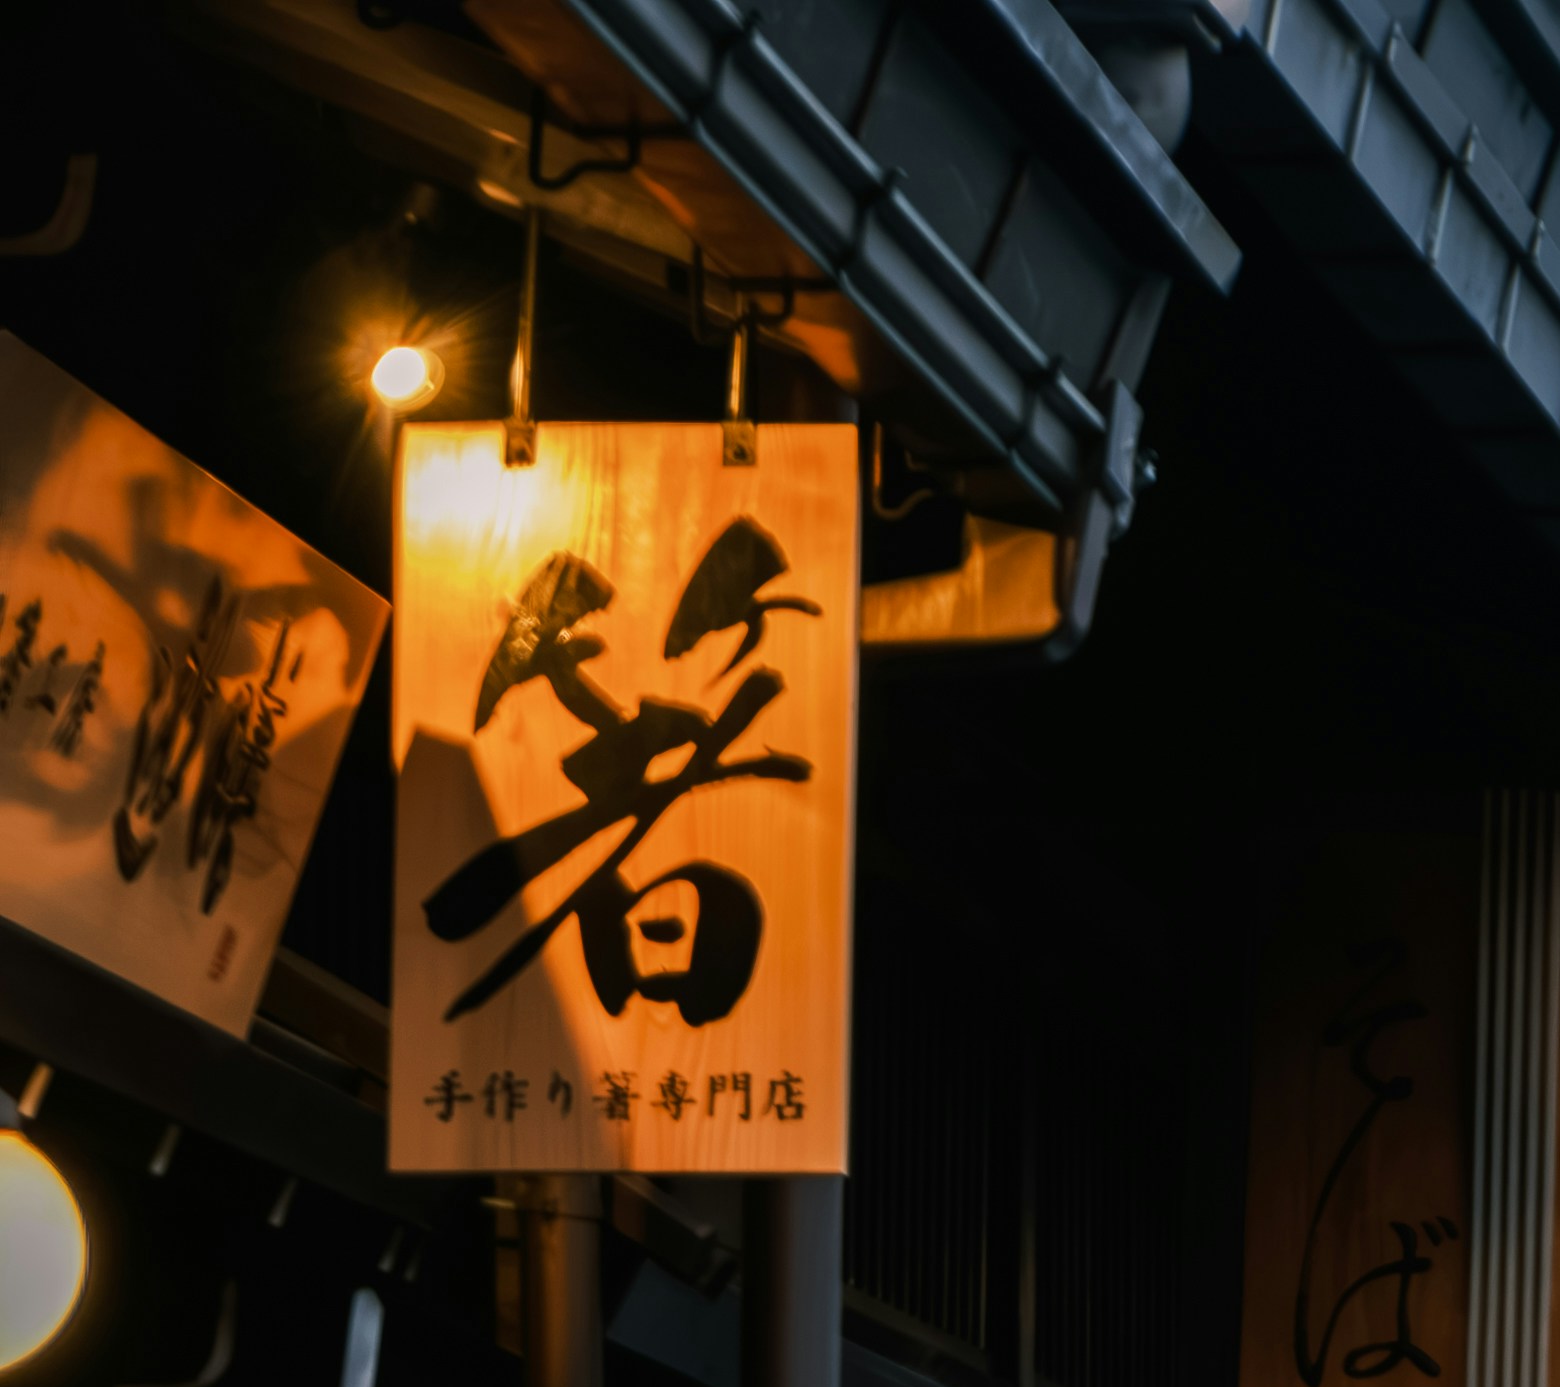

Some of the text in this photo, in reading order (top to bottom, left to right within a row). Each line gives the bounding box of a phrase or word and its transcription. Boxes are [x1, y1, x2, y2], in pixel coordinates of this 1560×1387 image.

[423, 514, 823, 1026] 箸
[424, 1069, 808, 1124] 手作り箸専門店
